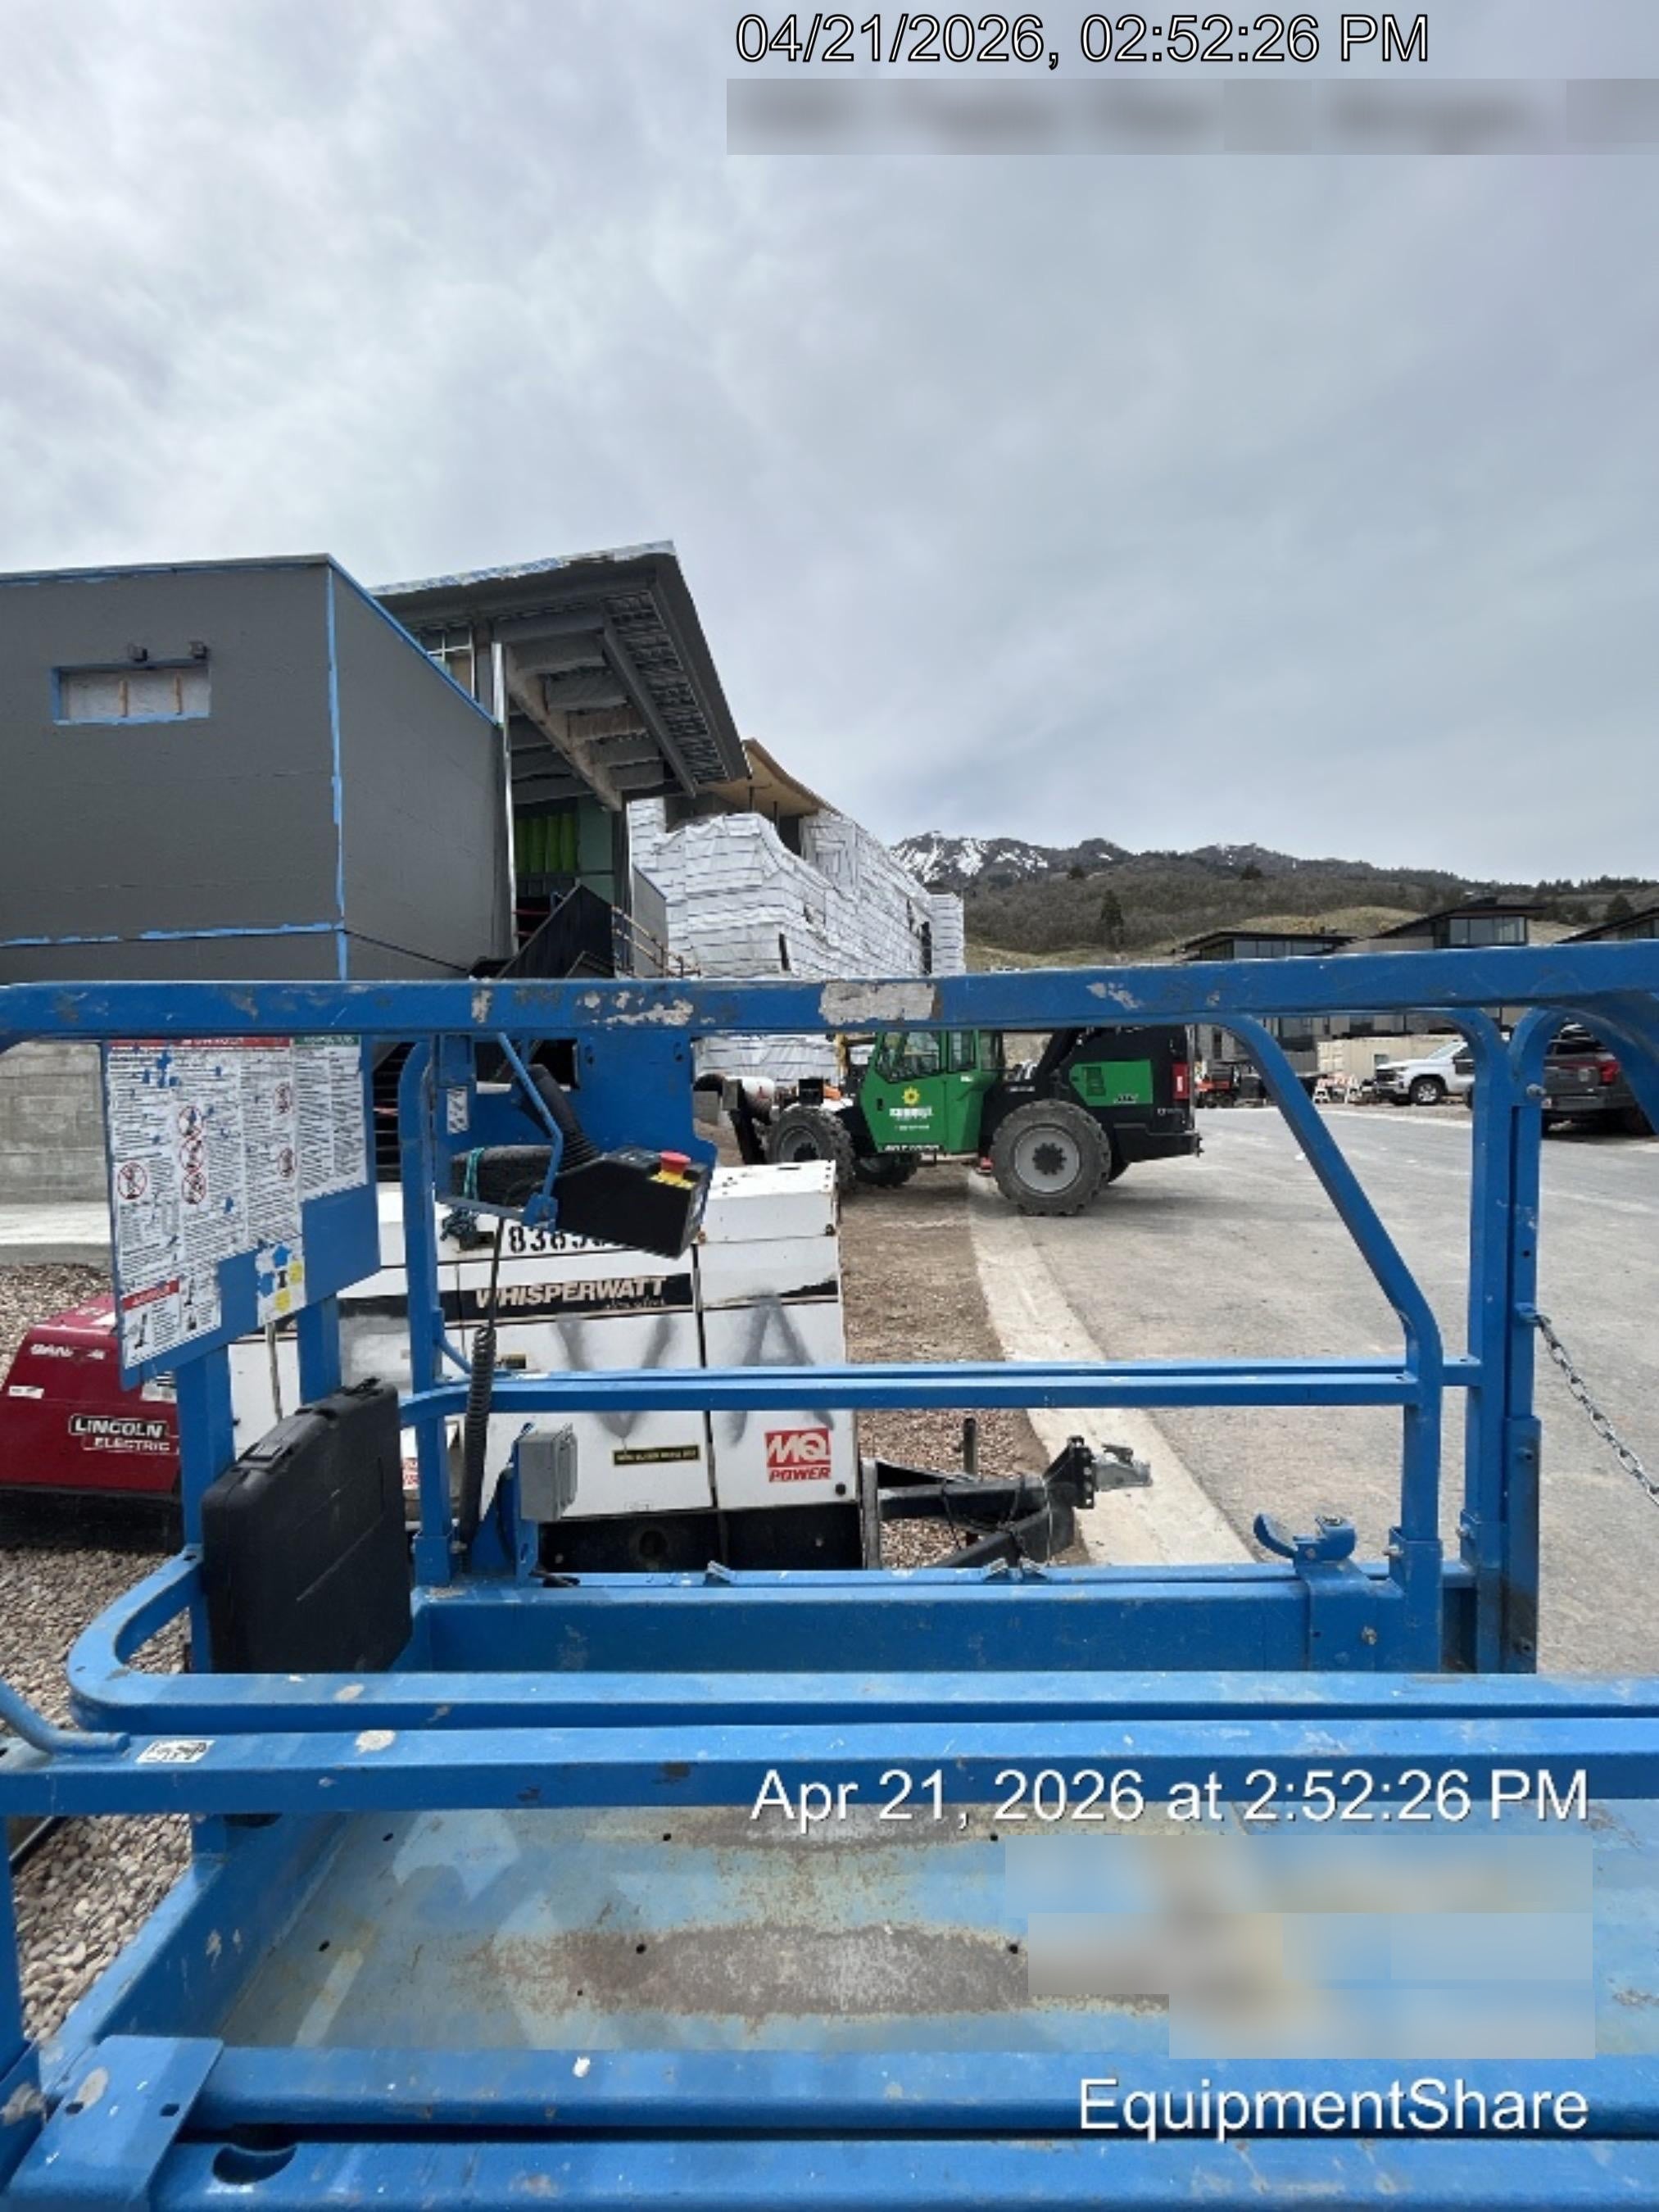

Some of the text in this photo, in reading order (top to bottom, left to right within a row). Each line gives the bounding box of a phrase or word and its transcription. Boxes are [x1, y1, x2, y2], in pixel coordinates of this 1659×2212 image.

[475, 1276, 667, 1309] WHISPERWATT
[75, 1416, 164, 1439] LINCOLN
[94, 1437, 170, 1451] ELECTRIC
[767, 1432, 831, 1463] MQ
[768, 1466, 831, 1482] POWER
